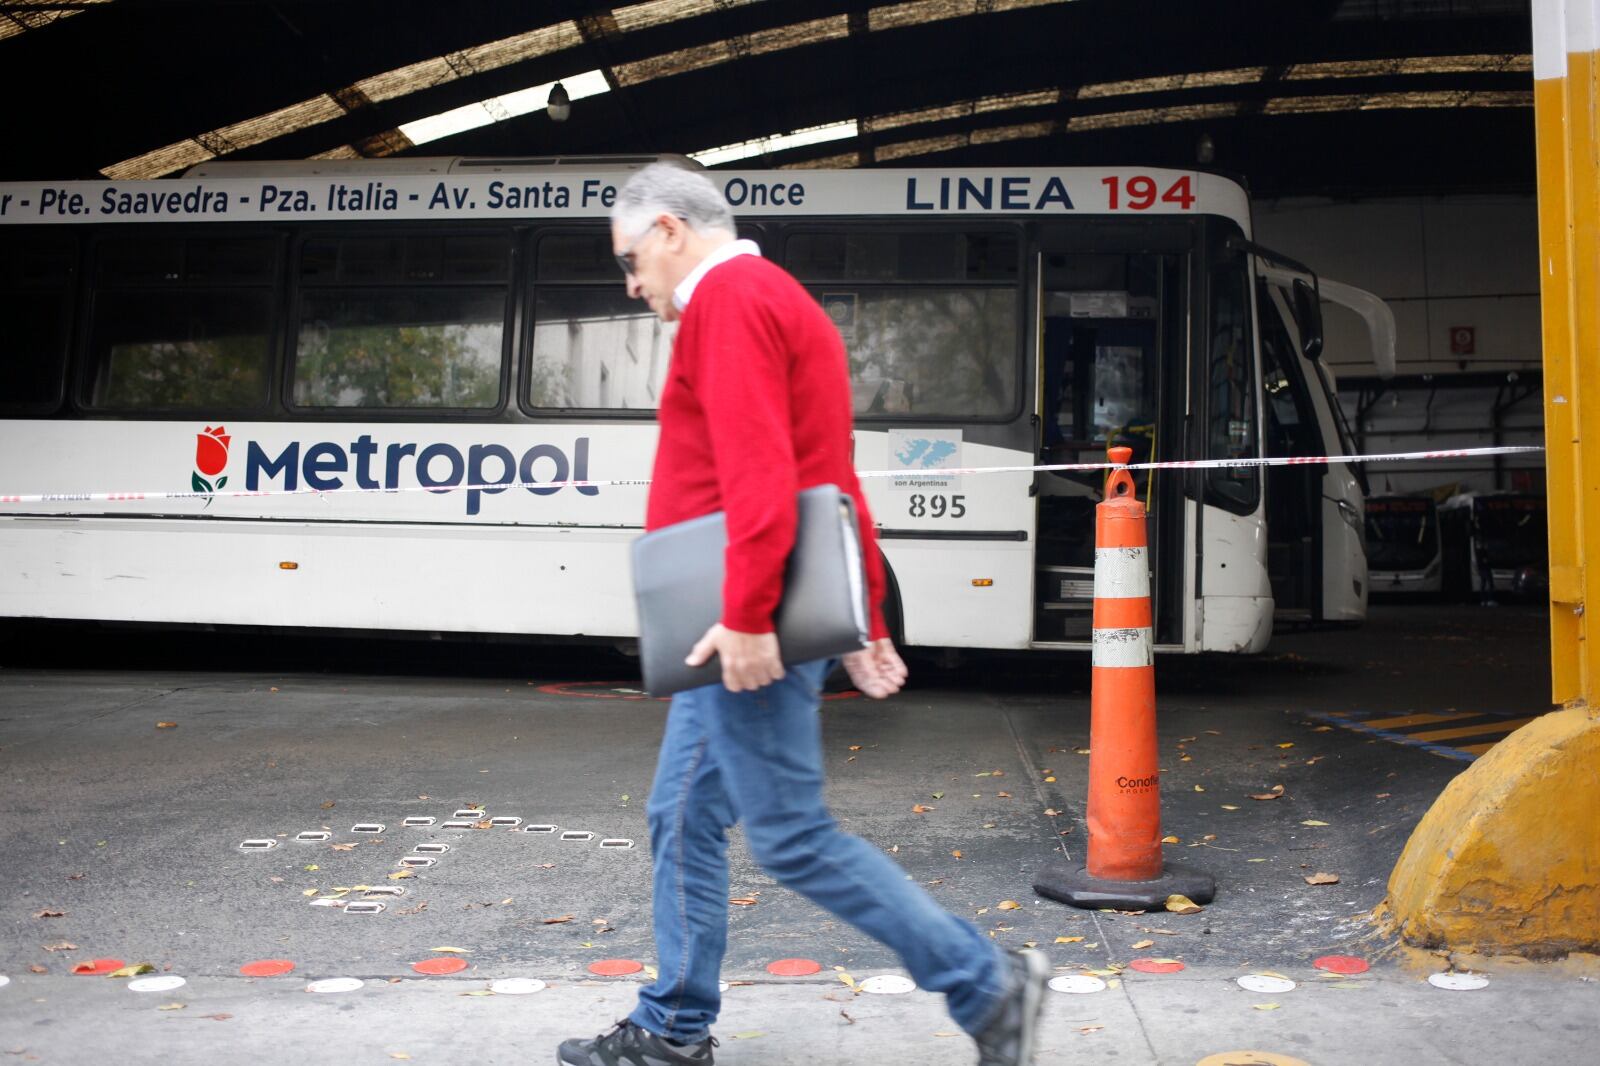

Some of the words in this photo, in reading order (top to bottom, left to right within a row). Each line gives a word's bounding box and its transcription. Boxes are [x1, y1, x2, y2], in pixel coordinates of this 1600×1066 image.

[39, 188, 91, 216] Pte.
[99, 185, 228, 215] Saavedra
[259, 184, 316, 212] Pza.
[328, 183, 398, 211] Italia
[429, 182, 476, 210] Av.
[486, 181, 570, 209] Santa
[581, 179, 616, 208] Fe
[724, 177, 805, 207] Once
[906, 176, 1075, 210] LINEA
[1102, 175, 1196, 211] 194
[245, 434, 600, 516] Metropol
[908, 480, 948, 489] Argentinas
[909, 494, 967, 519] 895
